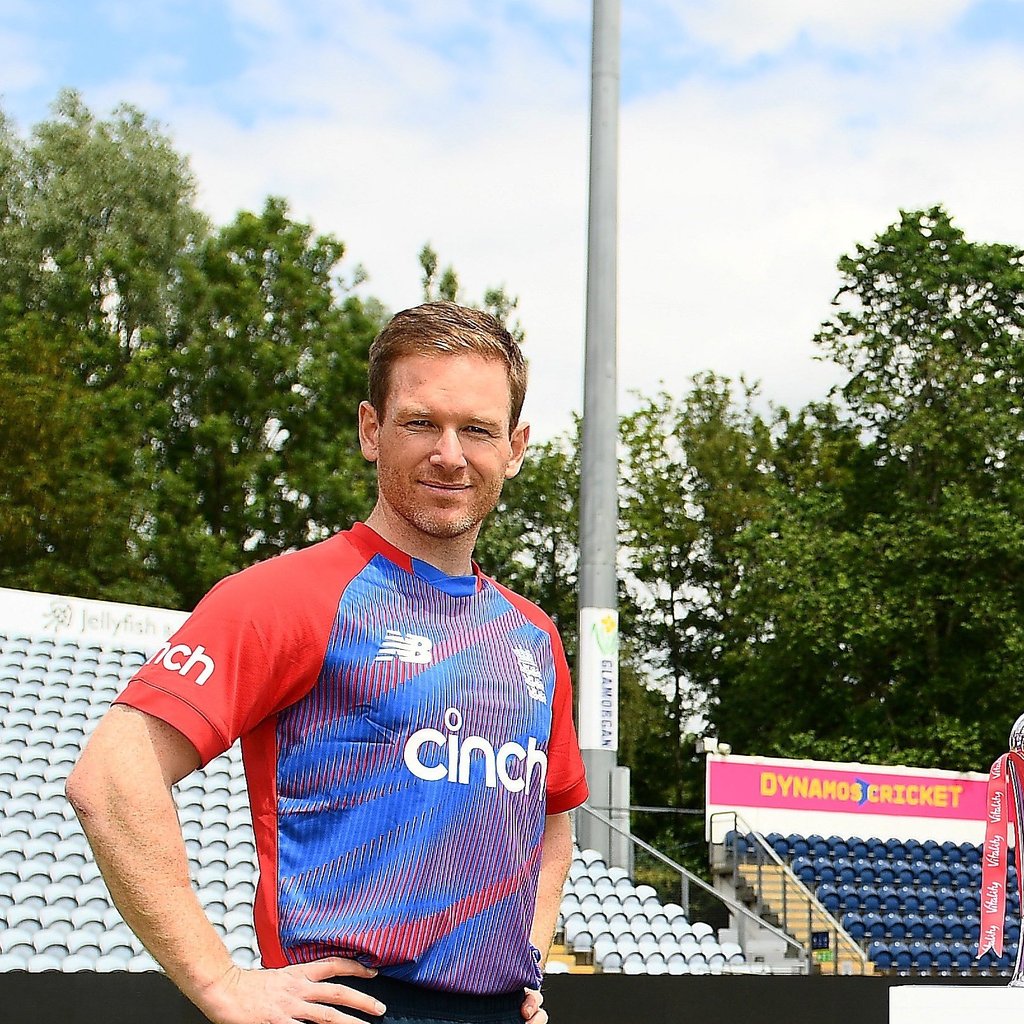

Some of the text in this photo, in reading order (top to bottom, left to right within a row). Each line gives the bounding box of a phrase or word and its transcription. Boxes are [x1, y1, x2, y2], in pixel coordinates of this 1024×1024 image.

[601, 660, 613, 748] GLAMORGAN
[403, 707, 548, 802] cinch
[760, 771, 964, 808] DYNAMOS CRICKET
[989, 791, 1004, 823] Vitality
[985, 835, 1004, 867] Vitality
[984, 881, 1002, 913] Vitality
